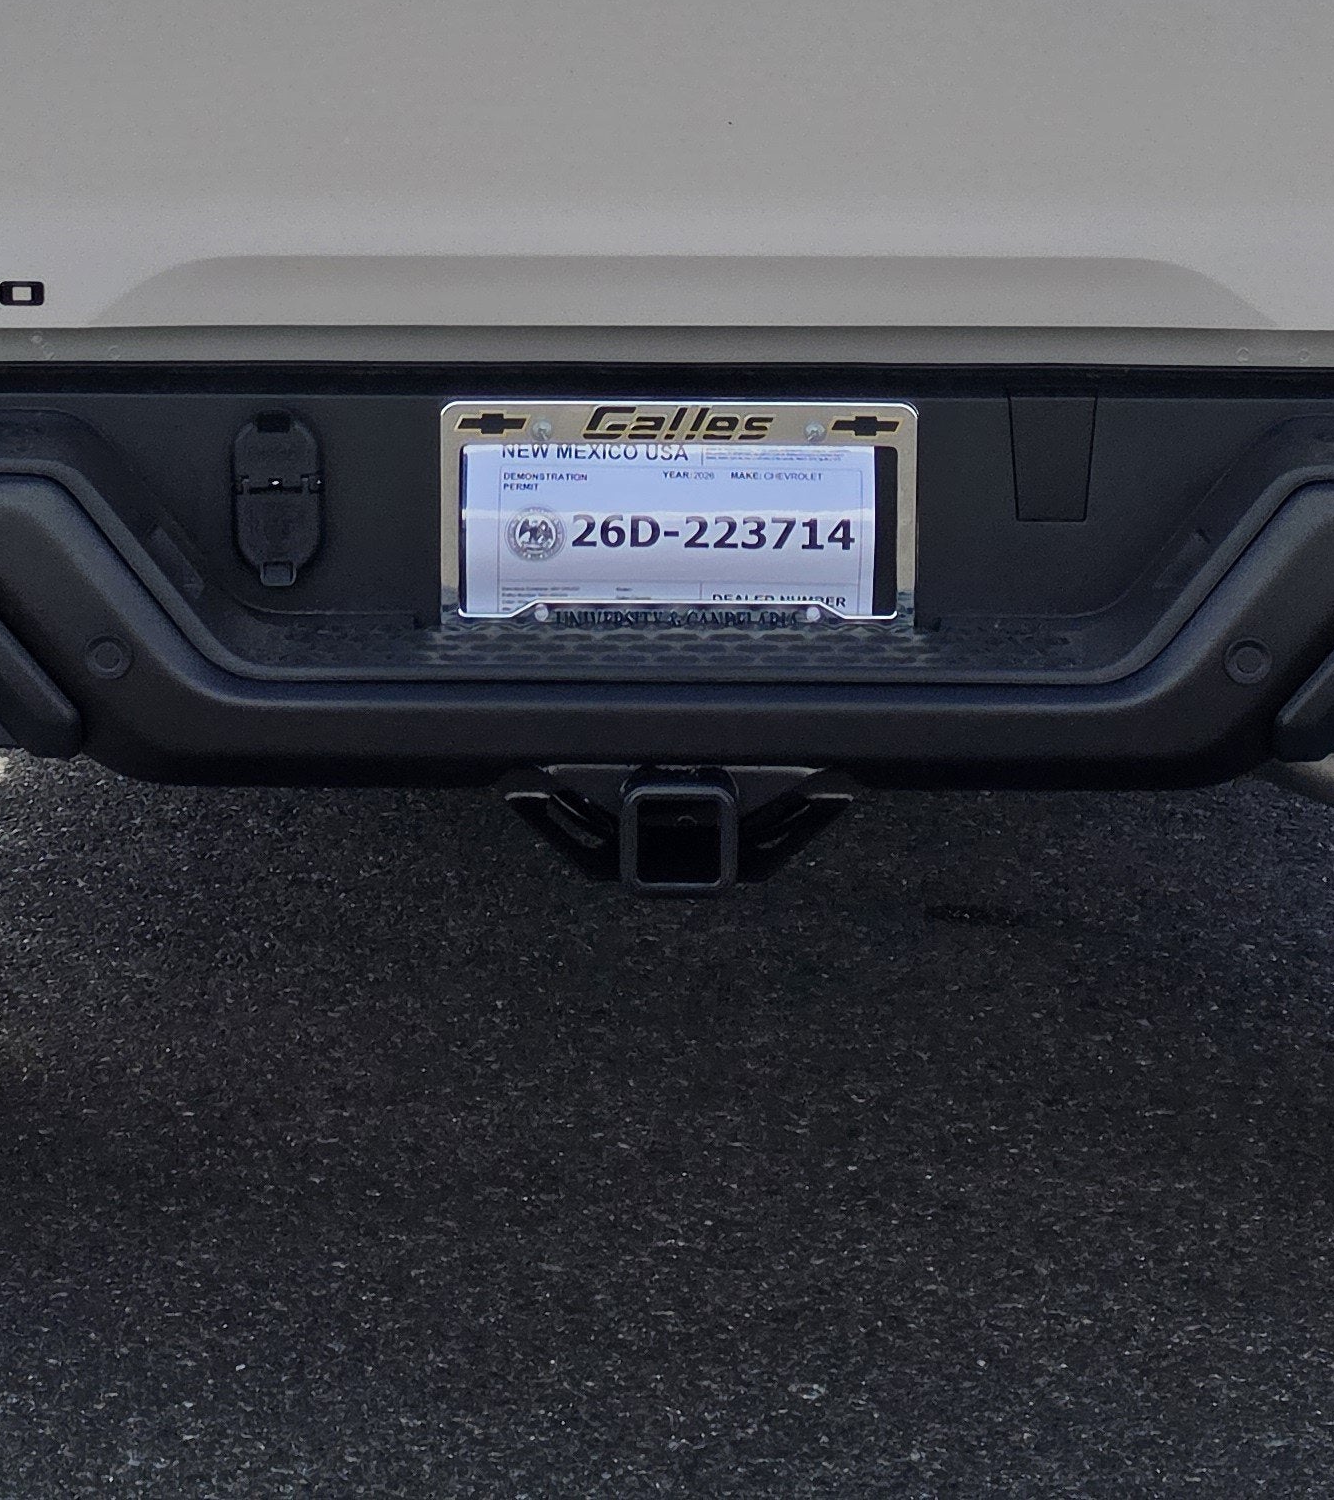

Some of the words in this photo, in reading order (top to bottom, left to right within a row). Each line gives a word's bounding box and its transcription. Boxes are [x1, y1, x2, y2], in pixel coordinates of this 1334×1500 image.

[582, 405, 775, 440] Galles
[502, 444, 549, 459] NEW
[555, 444, 639, 460] MEXICO
[645, 444, 689, 462] USA
[503, 472, 588, 482] DEMONSTRATION
[503, 482, 539, 491] PERMIT
[571, 514, 856, 551] 26D-223714
